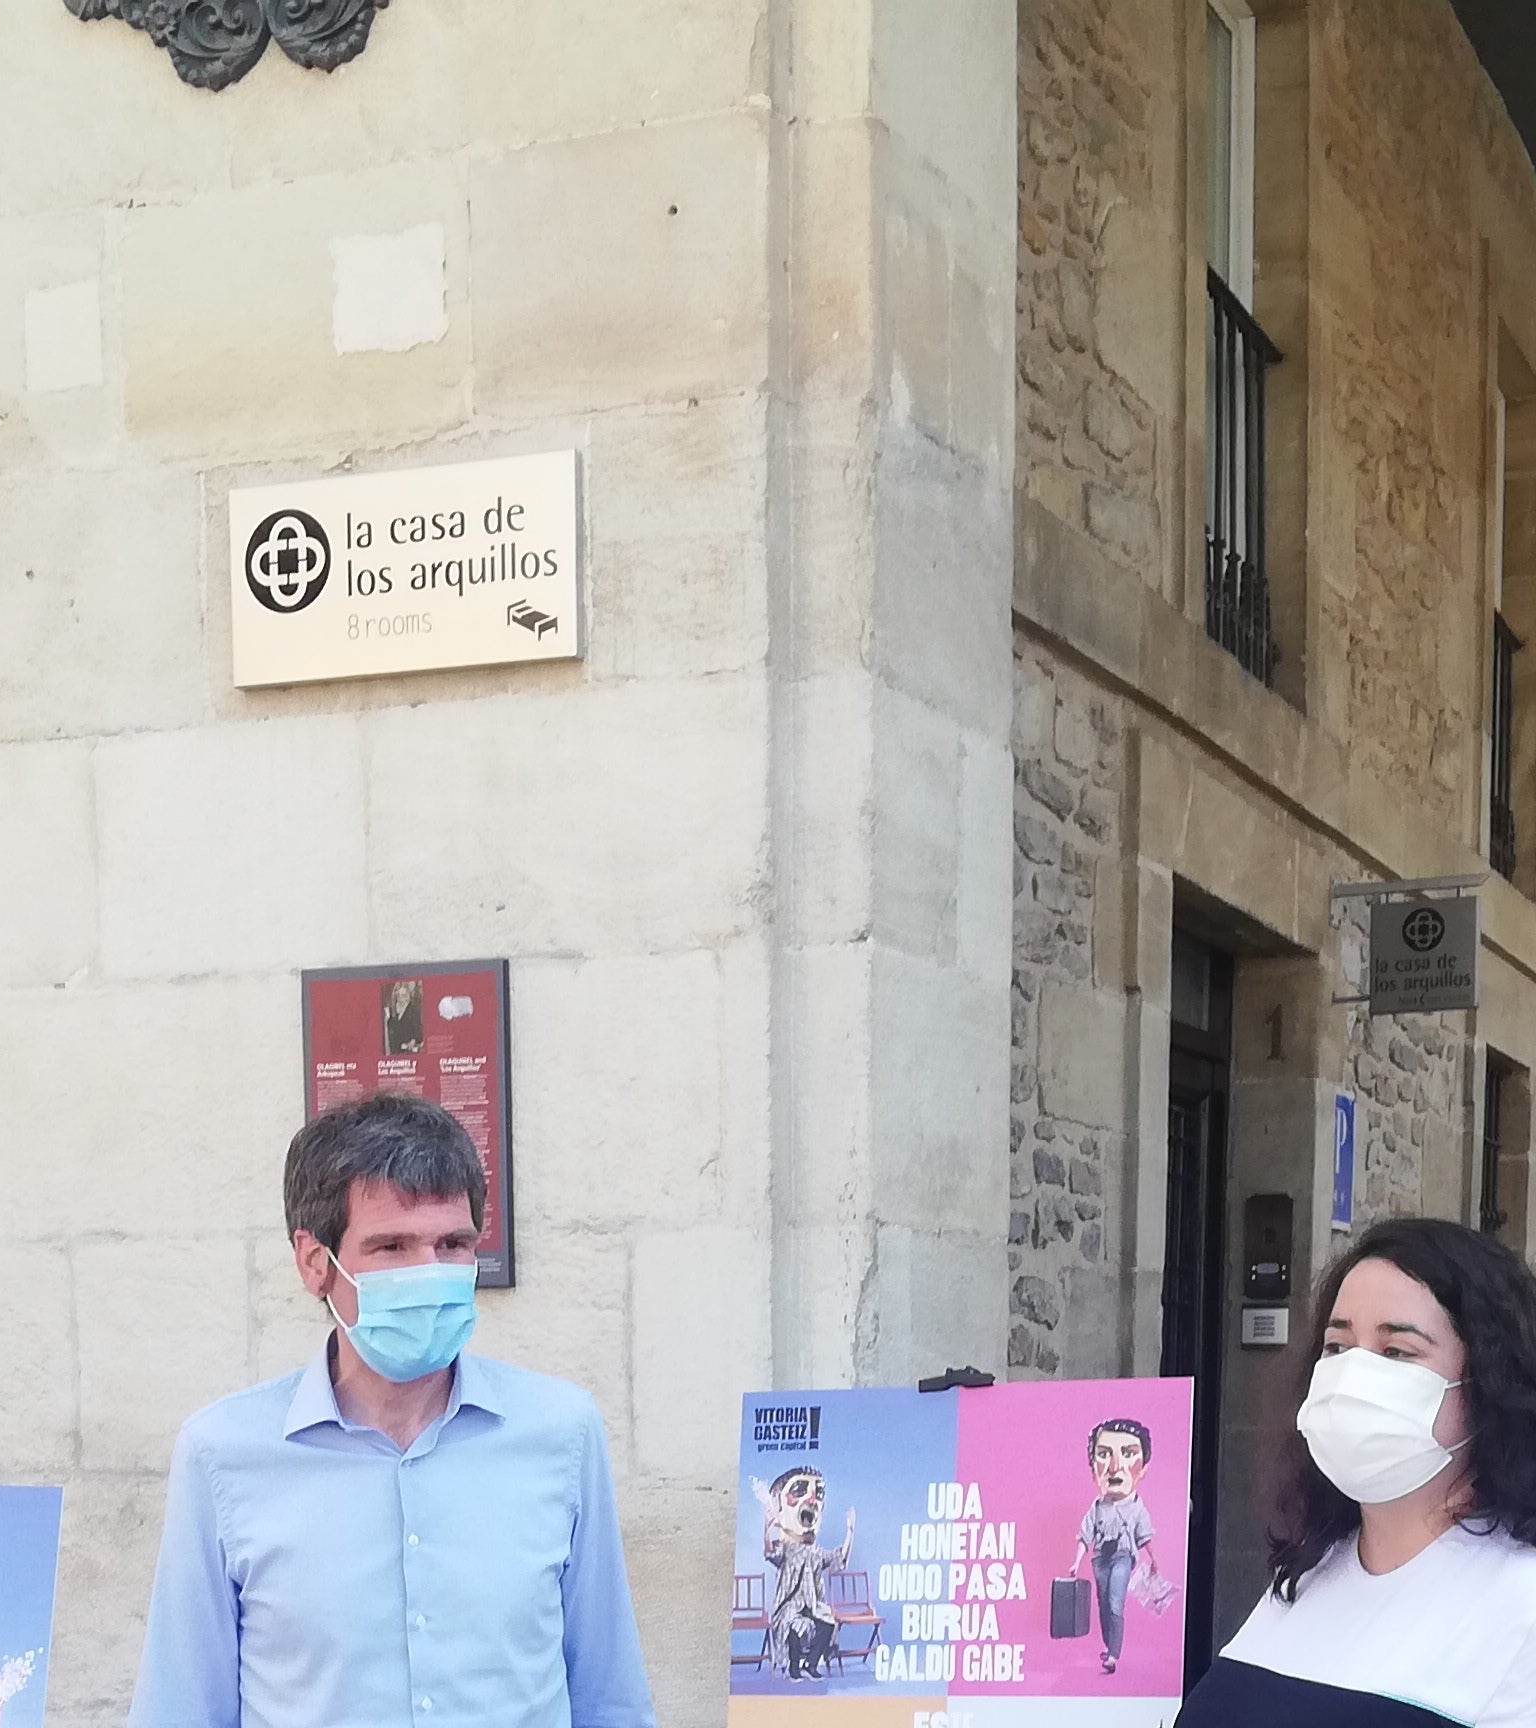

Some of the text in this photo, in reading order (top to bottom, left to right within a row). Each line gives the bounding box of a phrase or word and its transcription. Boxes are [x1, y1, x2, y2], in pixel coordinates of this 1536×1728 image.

[346, 496, 525, 550] la casa de
[347, 542, 558, 597] los arquillos
[365, 612, 432, 638] rooms
[1375, 953, 1457, 973] la casa de
[1375, 971, 1471, 992] los arquillos
[1265, 1003, 1287, 1063] 1
[754, 1407, 807, 1423] VITORIA
[754, 1424, 807, 1440] GASTEIZ
[927, 1482, 983, 1520] UDA
[901, 1522, 1015, 1560] HONETAN
[879, 1562, 1027, 1601] ONDO PASA
[902, 1603, 999, 1641] BURUA
[875, 1644, 1025, 1682] GALDU GABE
